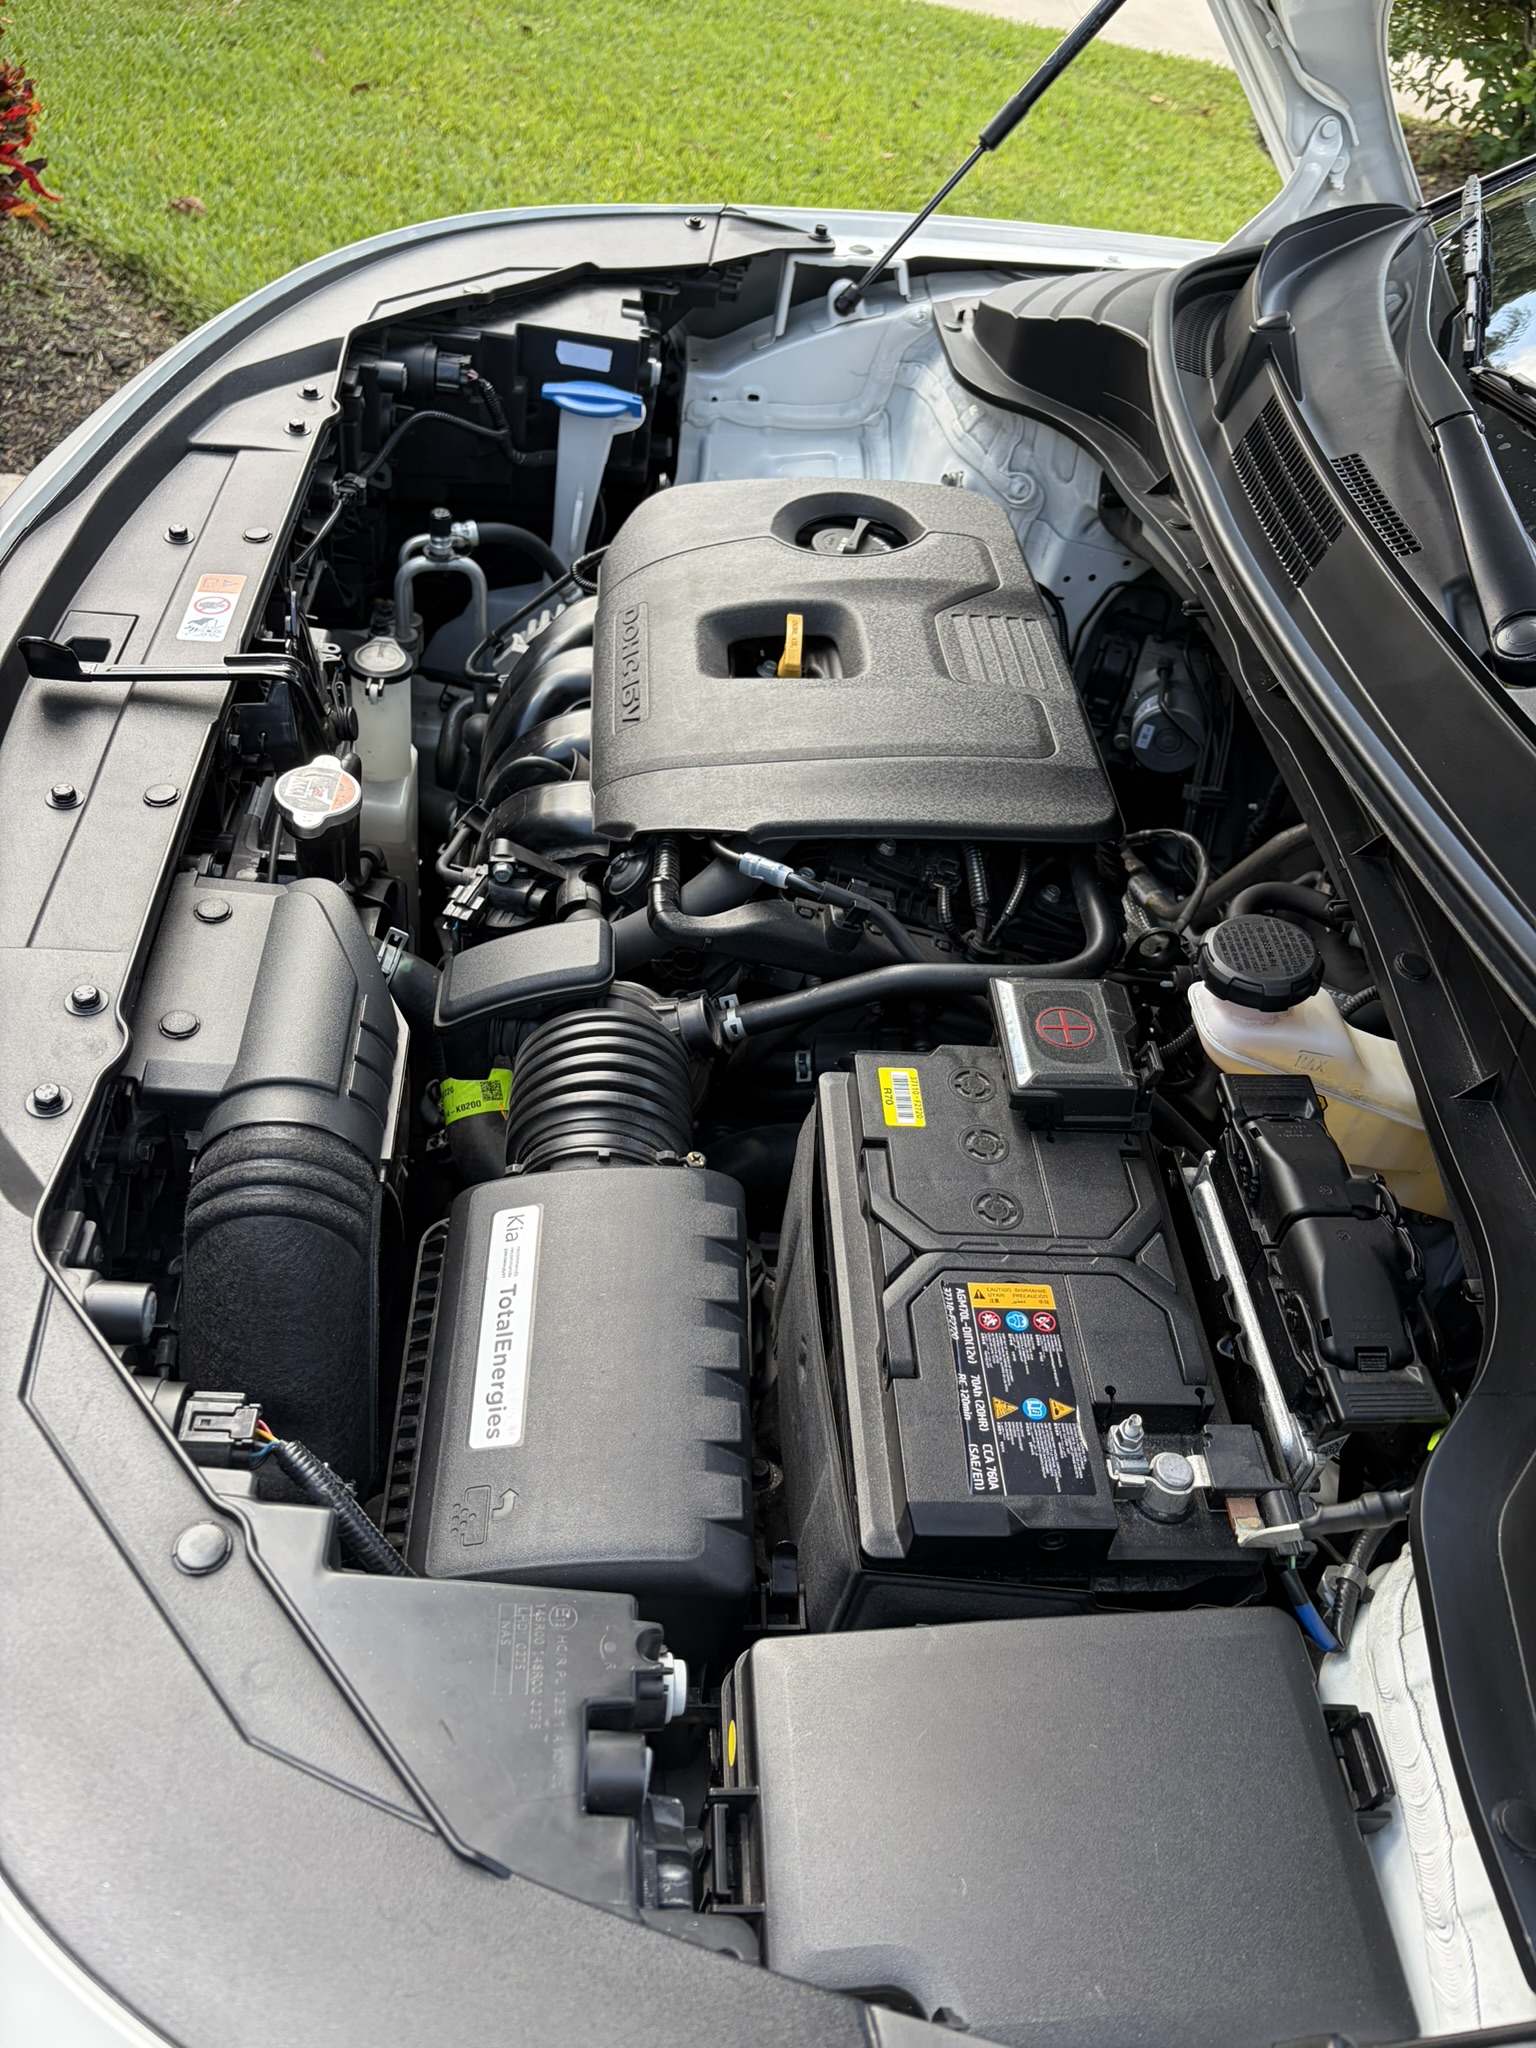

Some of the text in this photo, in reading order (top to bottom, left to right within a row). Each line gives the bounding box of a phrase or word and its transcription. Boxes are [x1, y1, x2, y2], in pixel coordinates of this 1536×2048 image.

[622, 604, 640, 723] DOHC 16V
[883, 1087, 893, 1106] R70
[909, 1076, 923, 1119] 37110-F2720
[486, 1214, 525, 1439] Kia TotalEnergies
[970, 1374, 983, 1397] 70Ah
[960, 1389, 972, 1421] 120min
[975, 1400, 989, 1432] (20HR)
[982, 1443, 995, 1464] CCA
[986, 1466, 999, 1490] 760A
[517, 1606, 529, 1631] LHD
[500, 1620, 512, 1646] NAS
